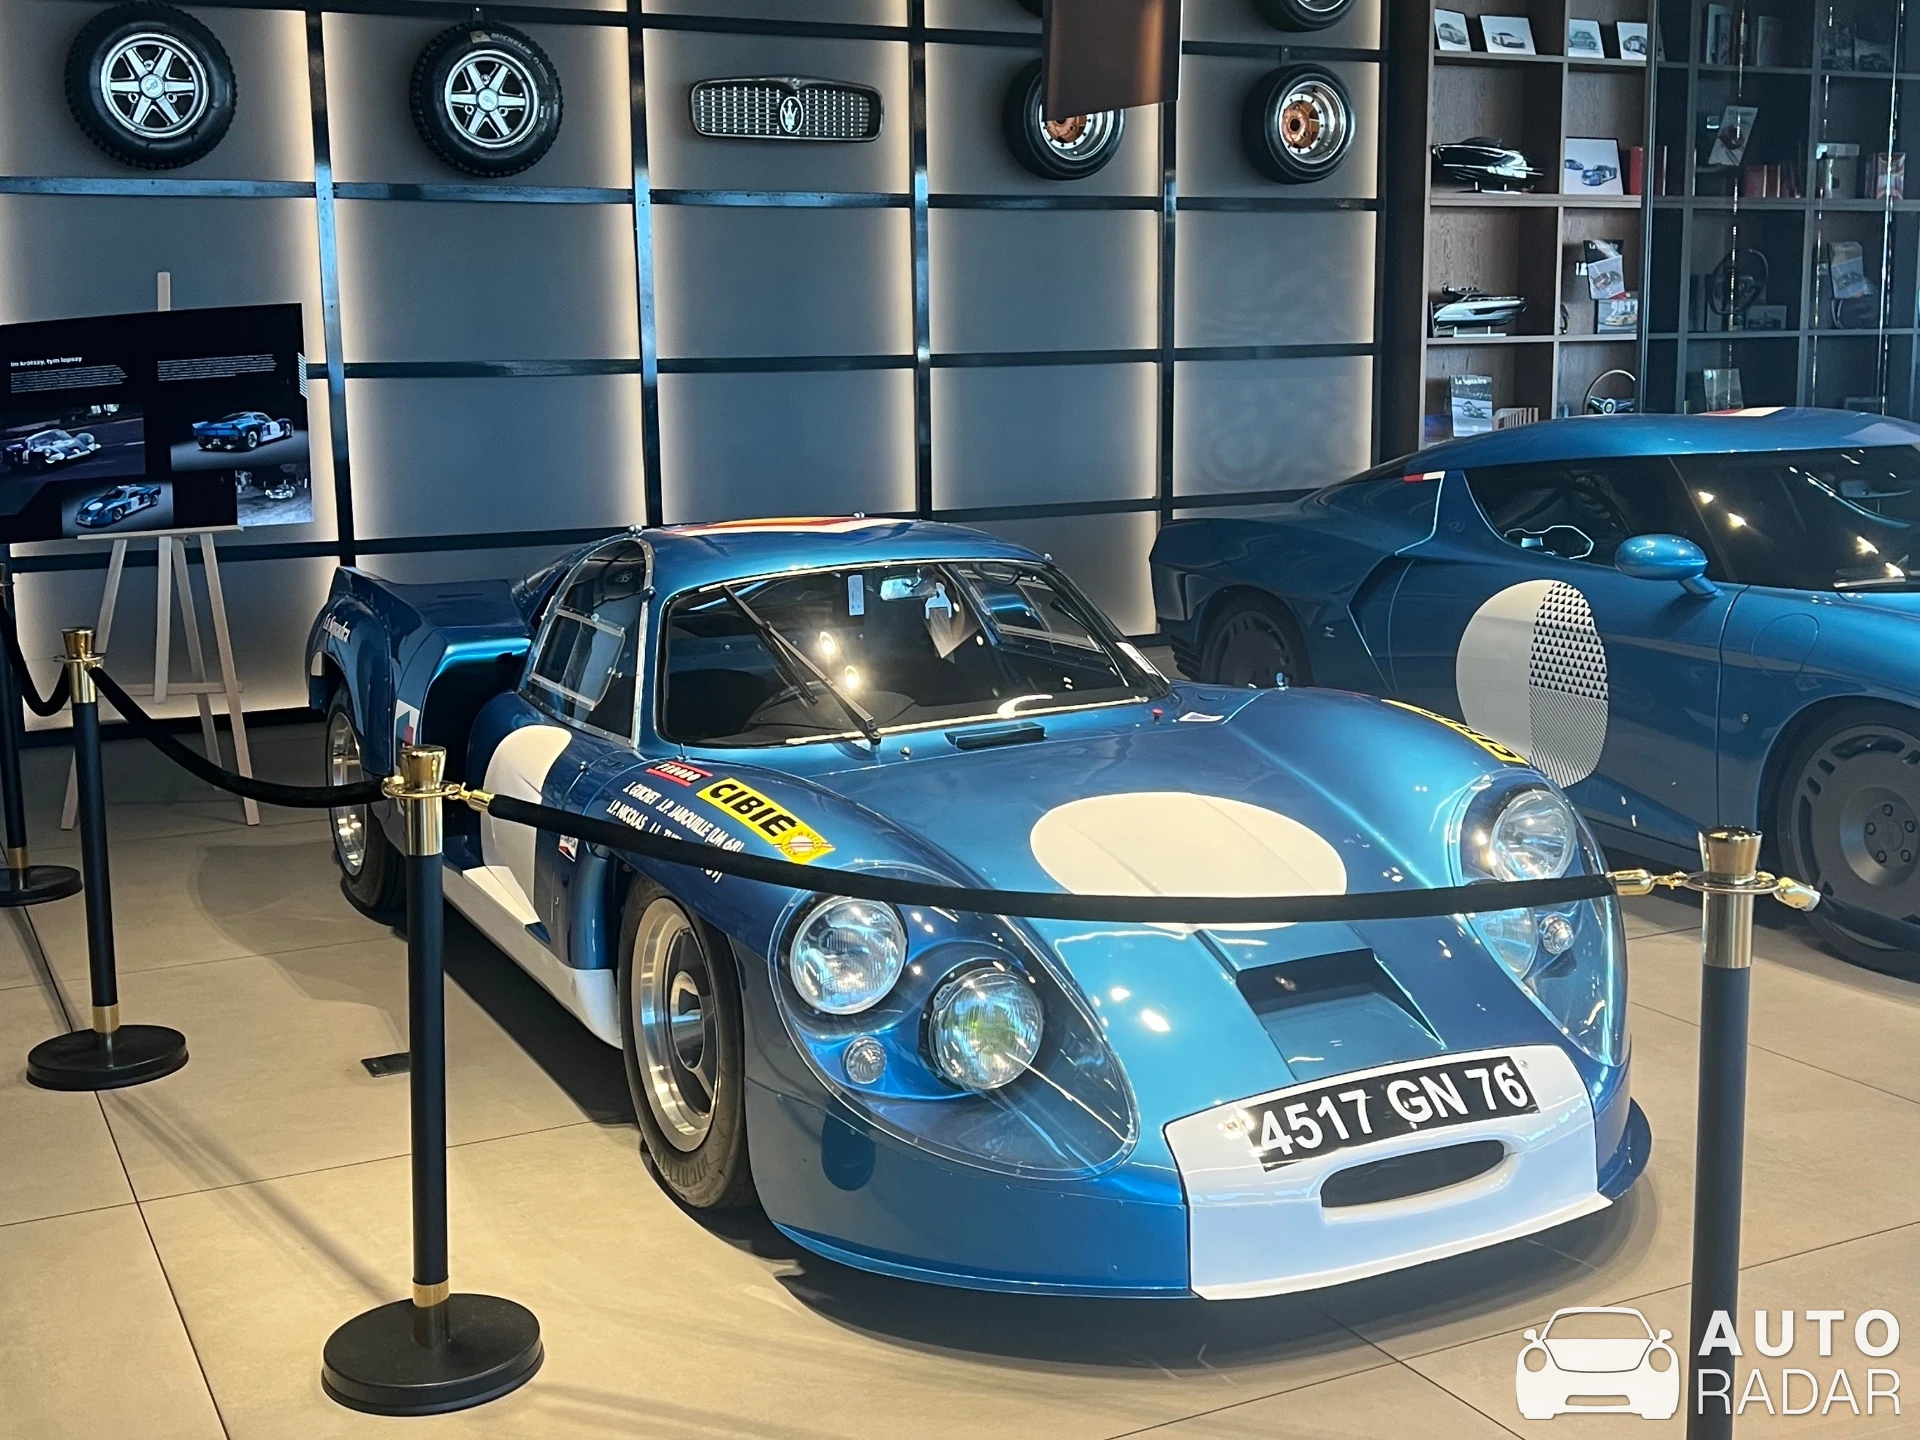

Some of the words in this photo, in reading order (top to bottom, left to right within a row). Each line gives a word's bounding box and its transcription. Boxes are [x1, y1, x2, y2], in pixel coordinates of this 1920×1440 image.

[1259, 1088, 1372, 1158] 4517
[1385, 1071, 1468, 1123] GN
[1465, 1062, 1529, 1111] 76
